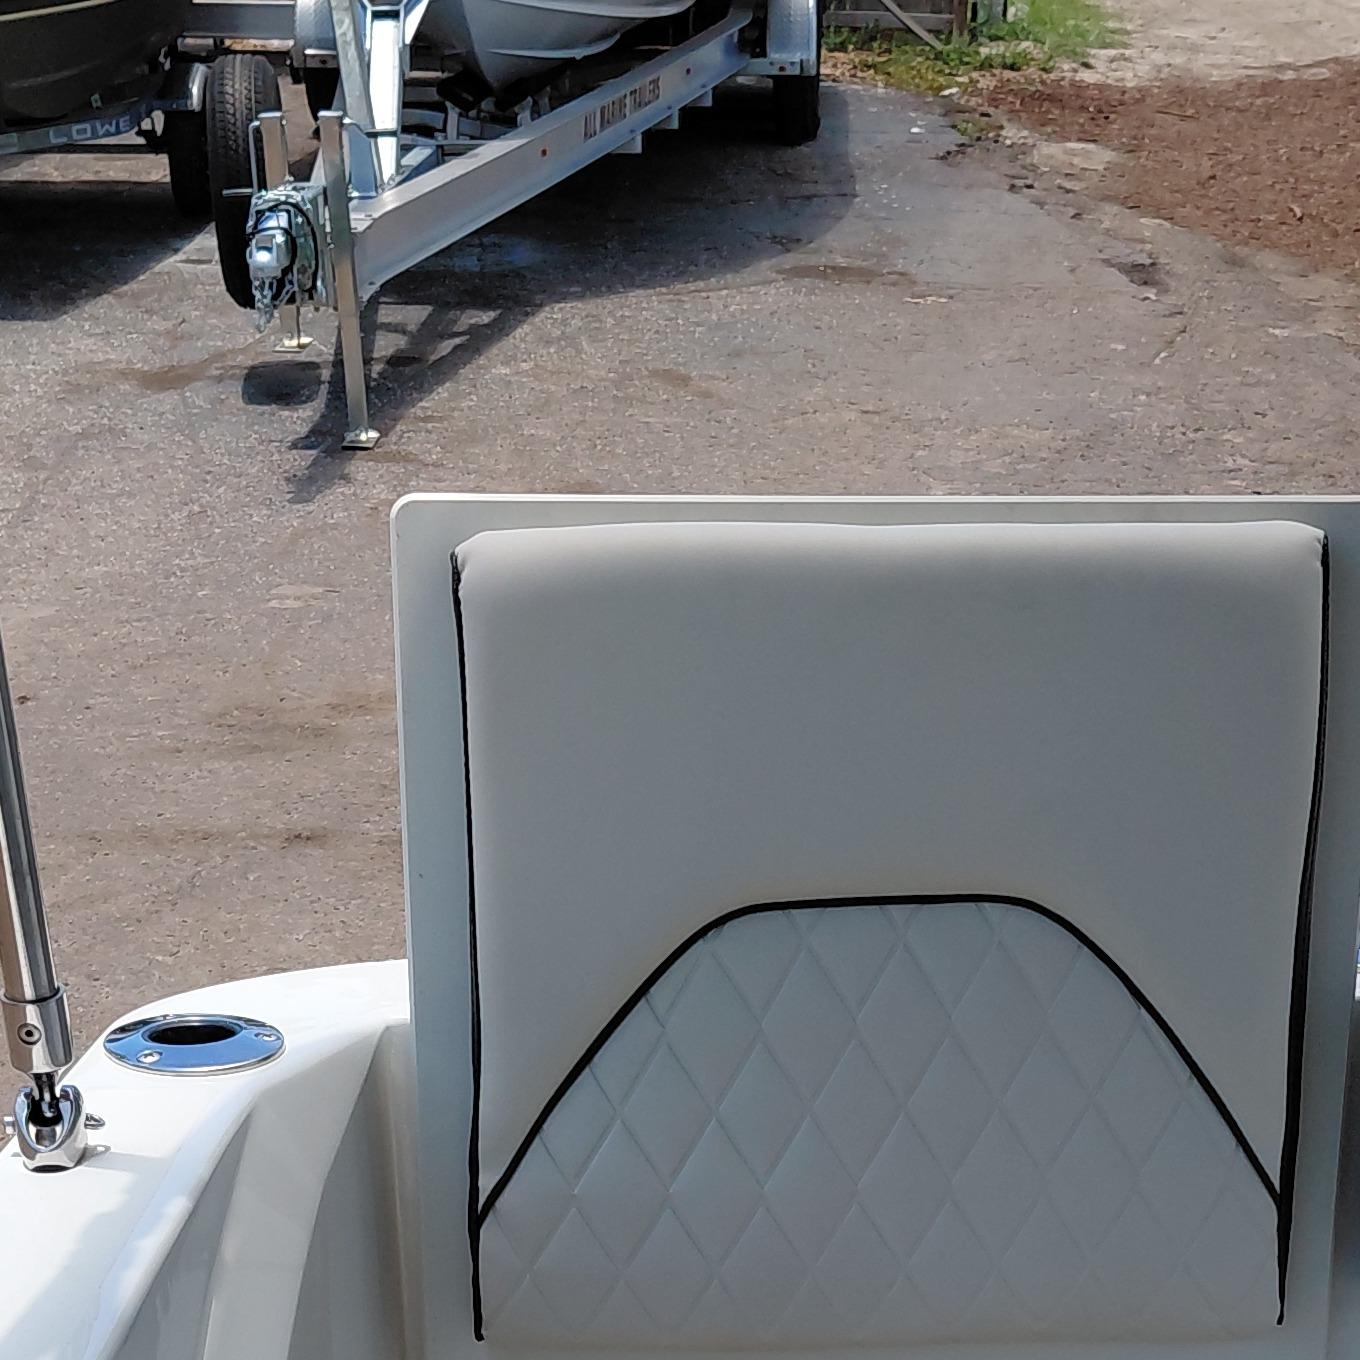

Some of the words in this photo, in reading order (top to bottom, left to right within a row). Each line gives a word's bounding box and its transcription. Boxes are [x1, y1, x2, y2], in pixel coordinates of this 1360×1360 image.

[49, 115, 131, 143] LOWE
[583, 110, 598, 142] ALL
[599, 92, 627, 131] MARINE
[629, 75, 661, 114] TRAILERS
